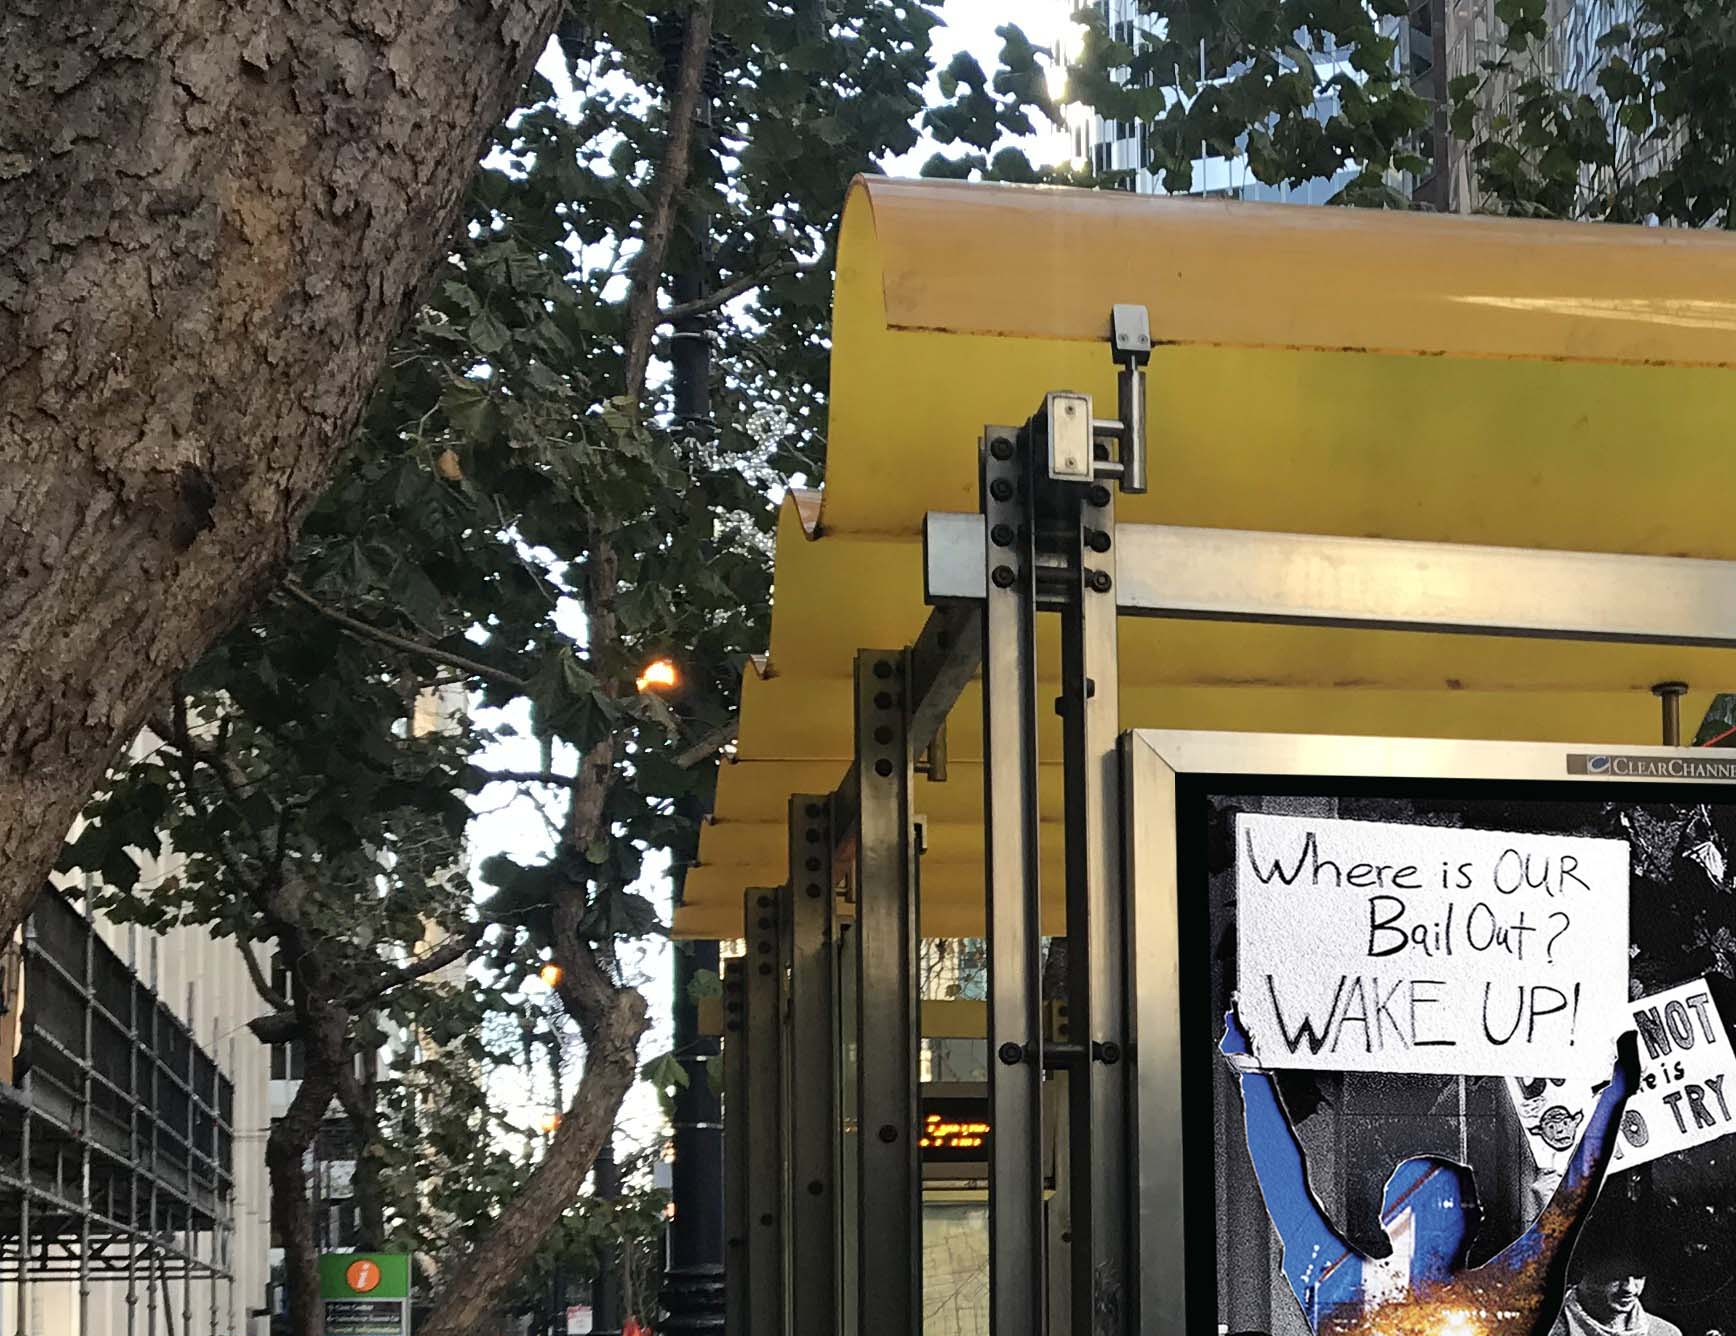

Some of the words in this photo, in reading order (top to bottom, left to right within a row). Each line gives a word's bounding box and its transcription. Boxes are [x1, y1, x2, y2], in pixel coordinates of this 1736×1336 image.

[1246, 828, 1422, 888] Where
[1443, 862, 1472, 889] is
[1494, 849, 1590, 897] OUR
[1368, 895, 1453, 957] Bail
[1266, 974, 1456, 1055] WAKE
[1483, 982, 1580, 1046] UP!
[1633, 993, 1716, 1059] NOT
[1661, 1061, 1686, 1083] is
[1663, 1074, 1732, 1133] TRY
